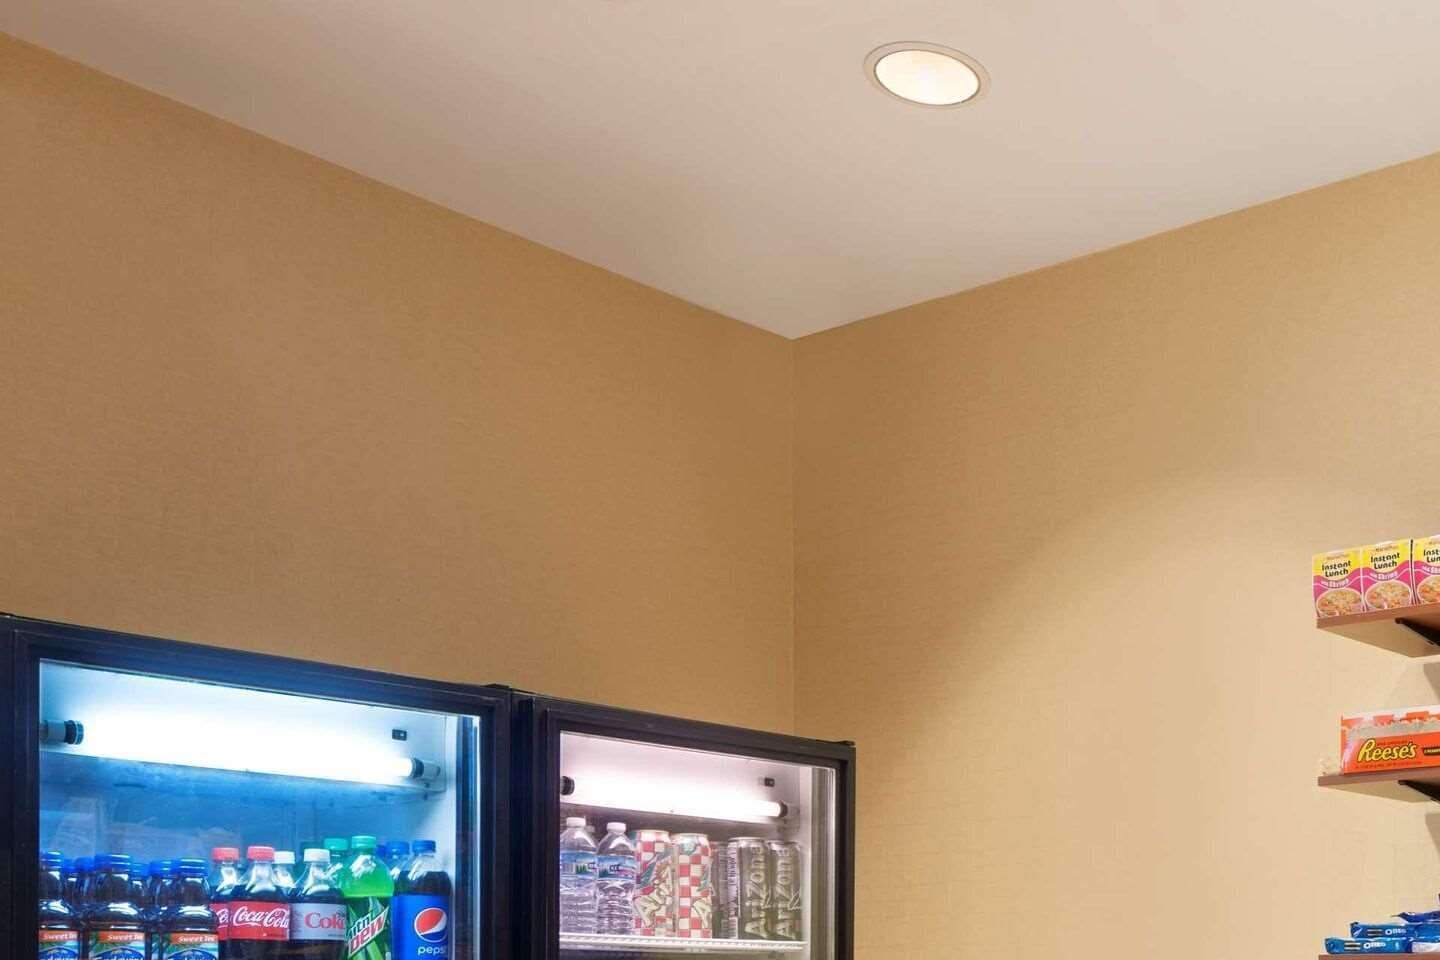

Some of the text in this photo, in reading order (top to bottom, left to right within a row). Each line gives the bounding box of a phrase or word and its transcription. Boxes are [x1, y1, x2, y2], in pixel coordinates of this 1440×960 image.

[1371, 553, 1400, 564] Instant
[1322, 560, 1351, 571] Instant
[1374, 560, 1397, 570] Lunch
[1325, 568, 1349, 578] Lunch
[1357, 738, 1417, 762] Reese's
[417, 944, 445, 957] peps
